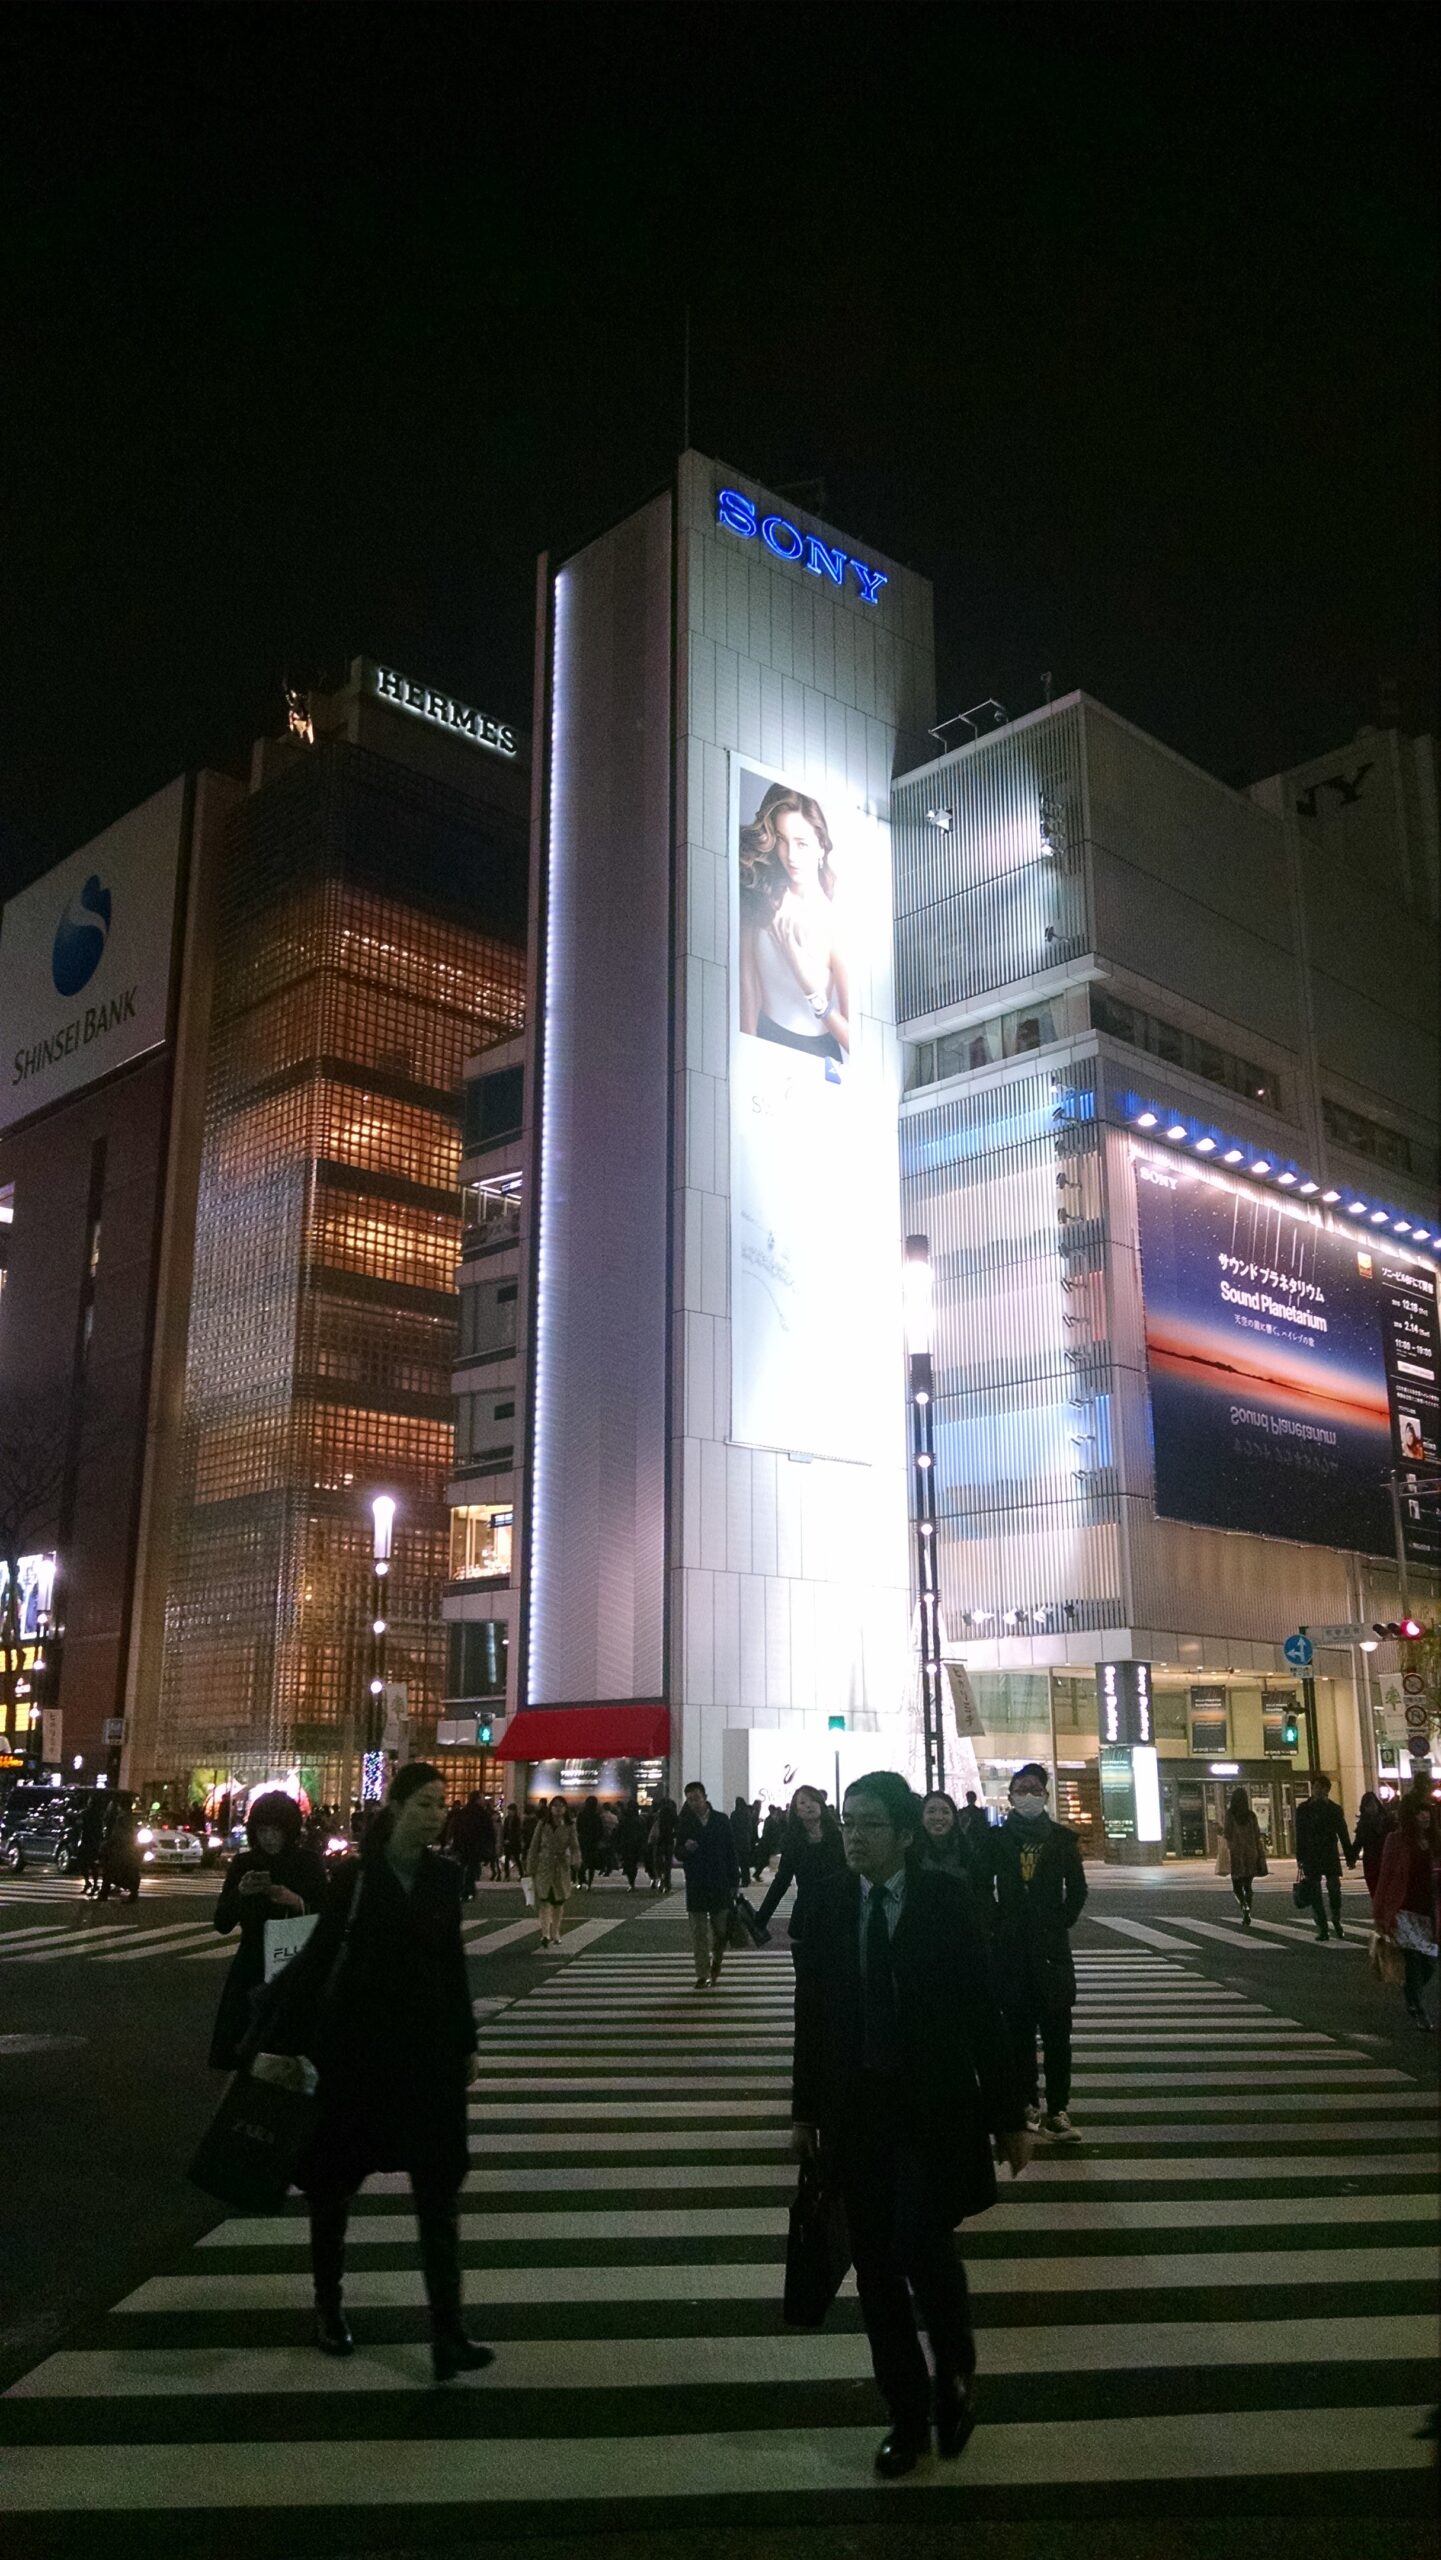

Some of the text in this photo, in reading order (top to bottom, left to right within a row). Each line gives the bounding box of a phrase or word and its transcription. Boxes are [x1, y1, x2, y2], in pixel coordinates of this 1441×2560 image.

[717, 489, 889, 605] SONY
[12, 985, 139, 1086] SHINSEI BANK
[1139, 1165, 1178, 1190] SONY
[1220, 1280, 1328, 1333] Sound Planetarium
